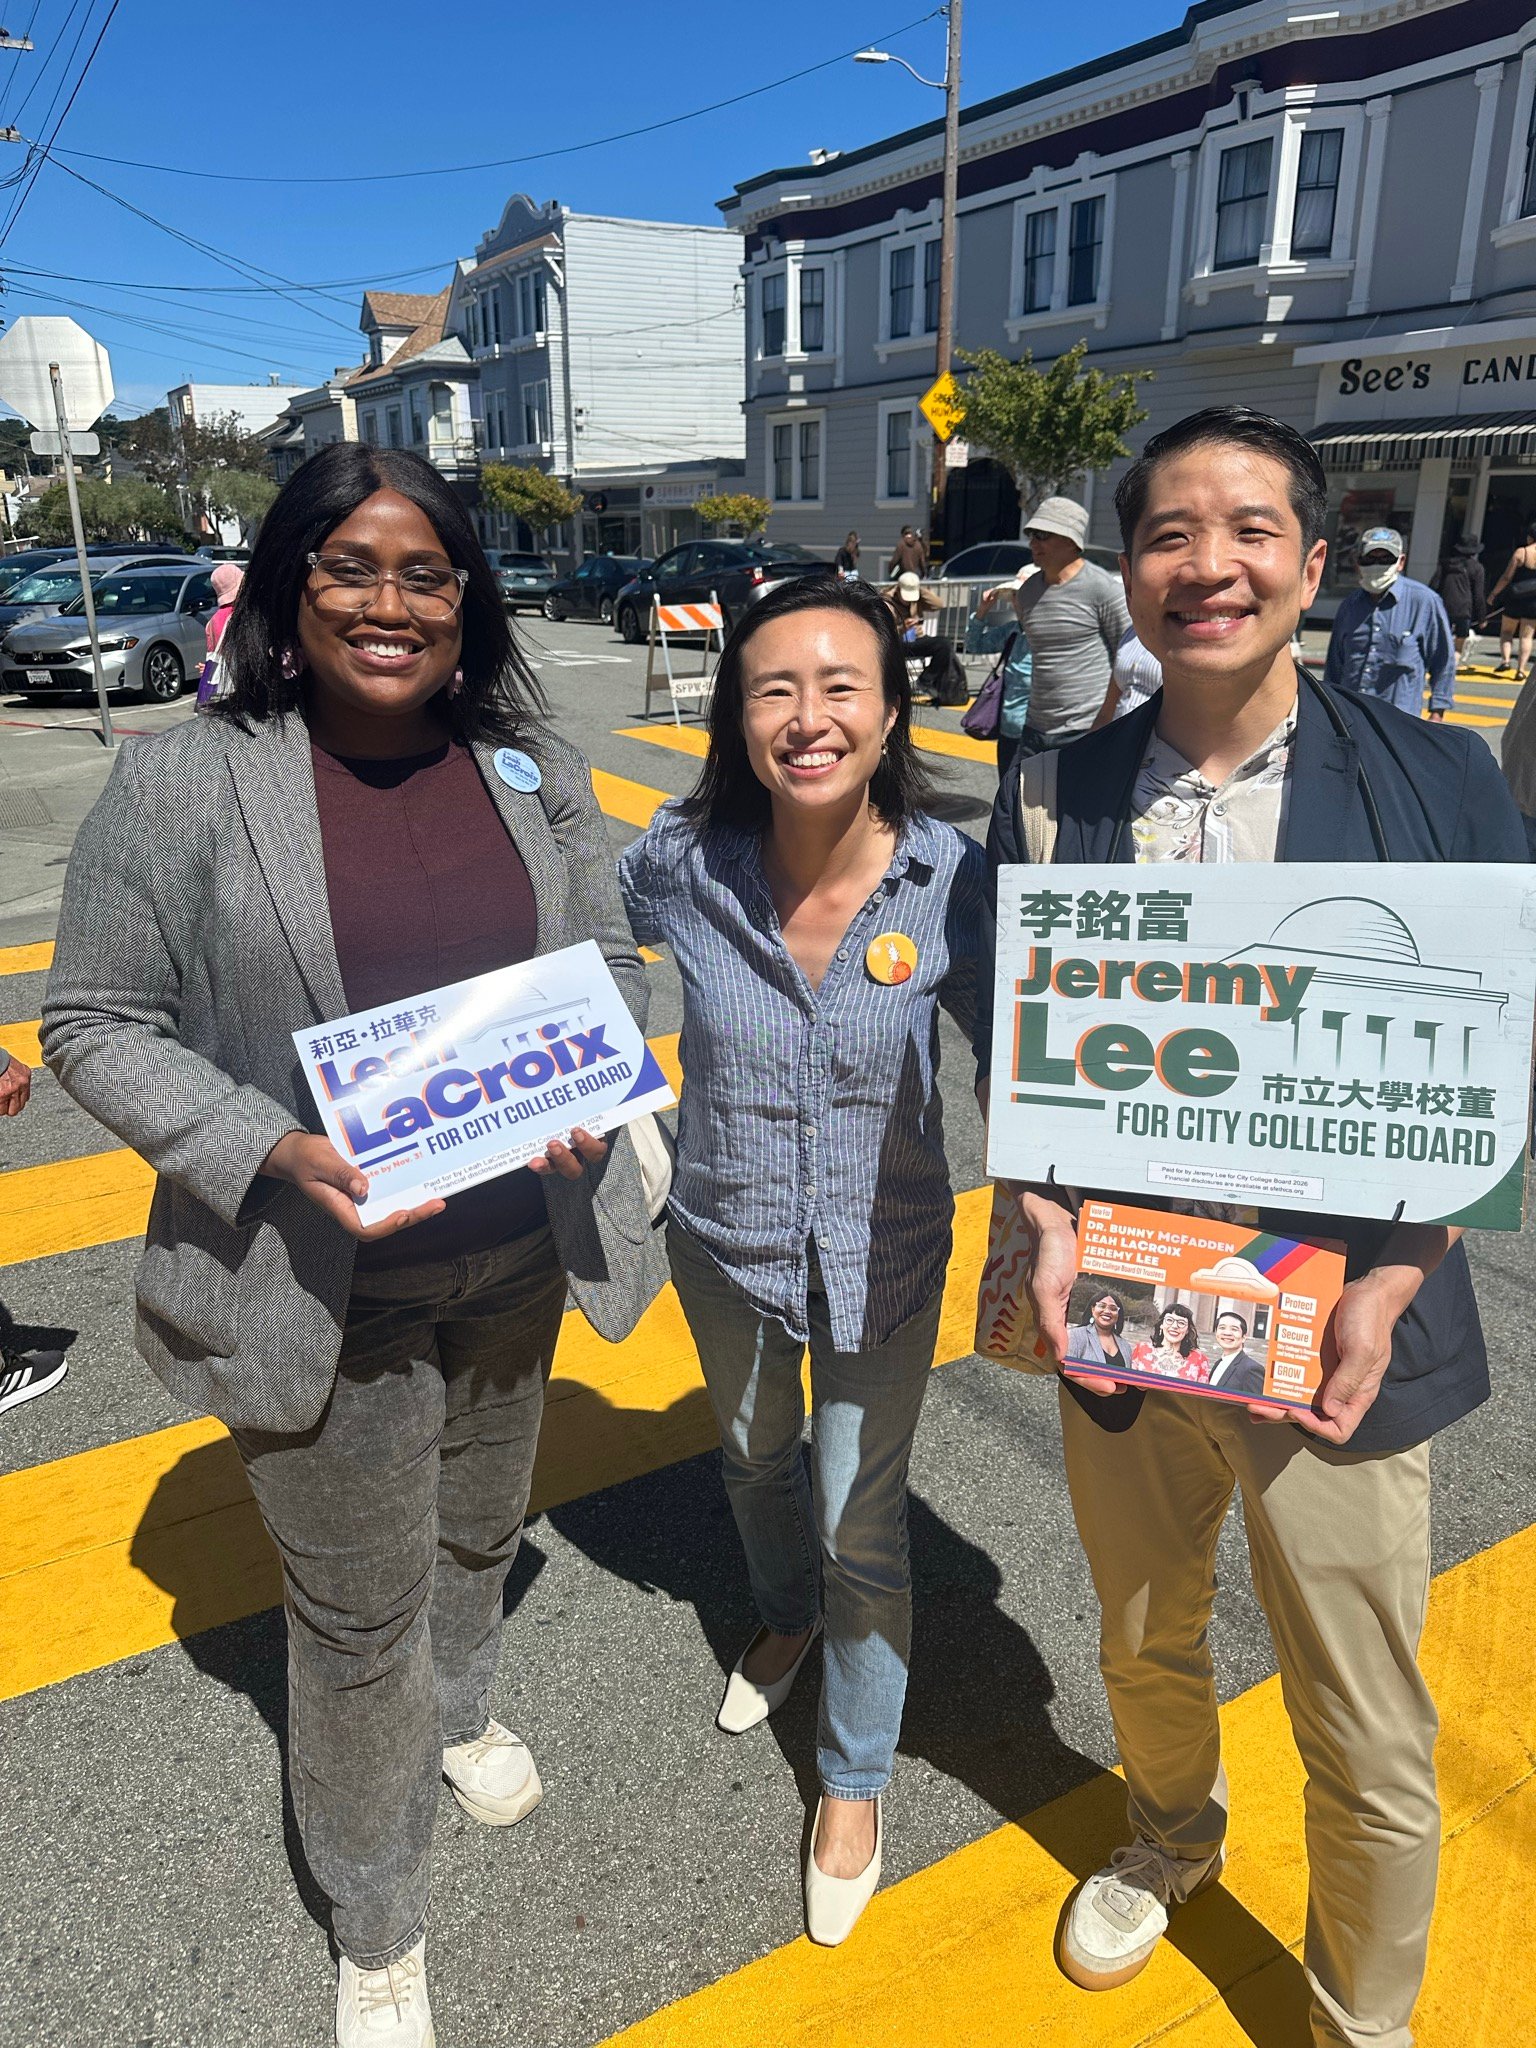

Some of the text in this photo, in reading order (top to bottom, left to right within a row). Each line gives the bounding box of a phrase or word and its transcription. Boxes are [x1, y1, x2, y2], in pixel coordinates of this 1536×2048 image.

[1339, 358, 1431, 395] See's
[502, 758, 539, 782] LaCroix
[1020, 889, 1193, 942] 李銘富
[1014, 945, 1318, 1023] Jeremy
[1011, 1000, 1241, 1098] Lee
[333, 1022, 621, 1157] LaCroix
[1262, 1073, 1497, 1120] 市立大學校董
[425, 1061, 633, 1155] FOR CITY COLLEGE BOARD
[1116, 1101, 1497, 1167] FOR CITY COLLEGE BOARD
[380, 1165, 391, 1174] by
[392, 1157, 413, 1169] Nov.
[424, 1179, 441, 1189] Paid
[441, 1174, 452, 1183] for
[452, 1170, 463, 1179] by
[463, 1162, 482, 1174] Leah
[482, 1151, 510, 1165] LaCroix
[511, 1146, 521, 1155] for
[522, 1140, 536, 1151] City
[587, 1114, 604, 1126] 2026
[433, 1176, 467, 1192] Financial
[467, 1160, 508, 1180] disclosures
[508, 1155, 521, 1164] are
[1164, 1174, 1191, 1182] Financial
[1190, 1177, 1223, 1186] disclosures
[1235, 1182, 1262, 1190] available
[1192, 1170, 1215, 1178] Jeremy
[1236, 1174, 1249, 1182] City
[1249, 1175, 1273, 1184] College
[1273, 1177, 1292, 1185] Board
[1292, 1179, 1309, 1187] 2026
[1085, 1232, 1118, 1246] LEAH
[1086, 1220, 1107, 1232] DR.
[1109, 1223, 1155, 1239] BUNNY
[1083, 1245, 1160, 1266] JEREMY LEE
[1284, 1296, 1314, 1311] Protect
[1281, 1328, 1309, 1342] Secure
[1277, 1365, 1302, 1379] GROW
